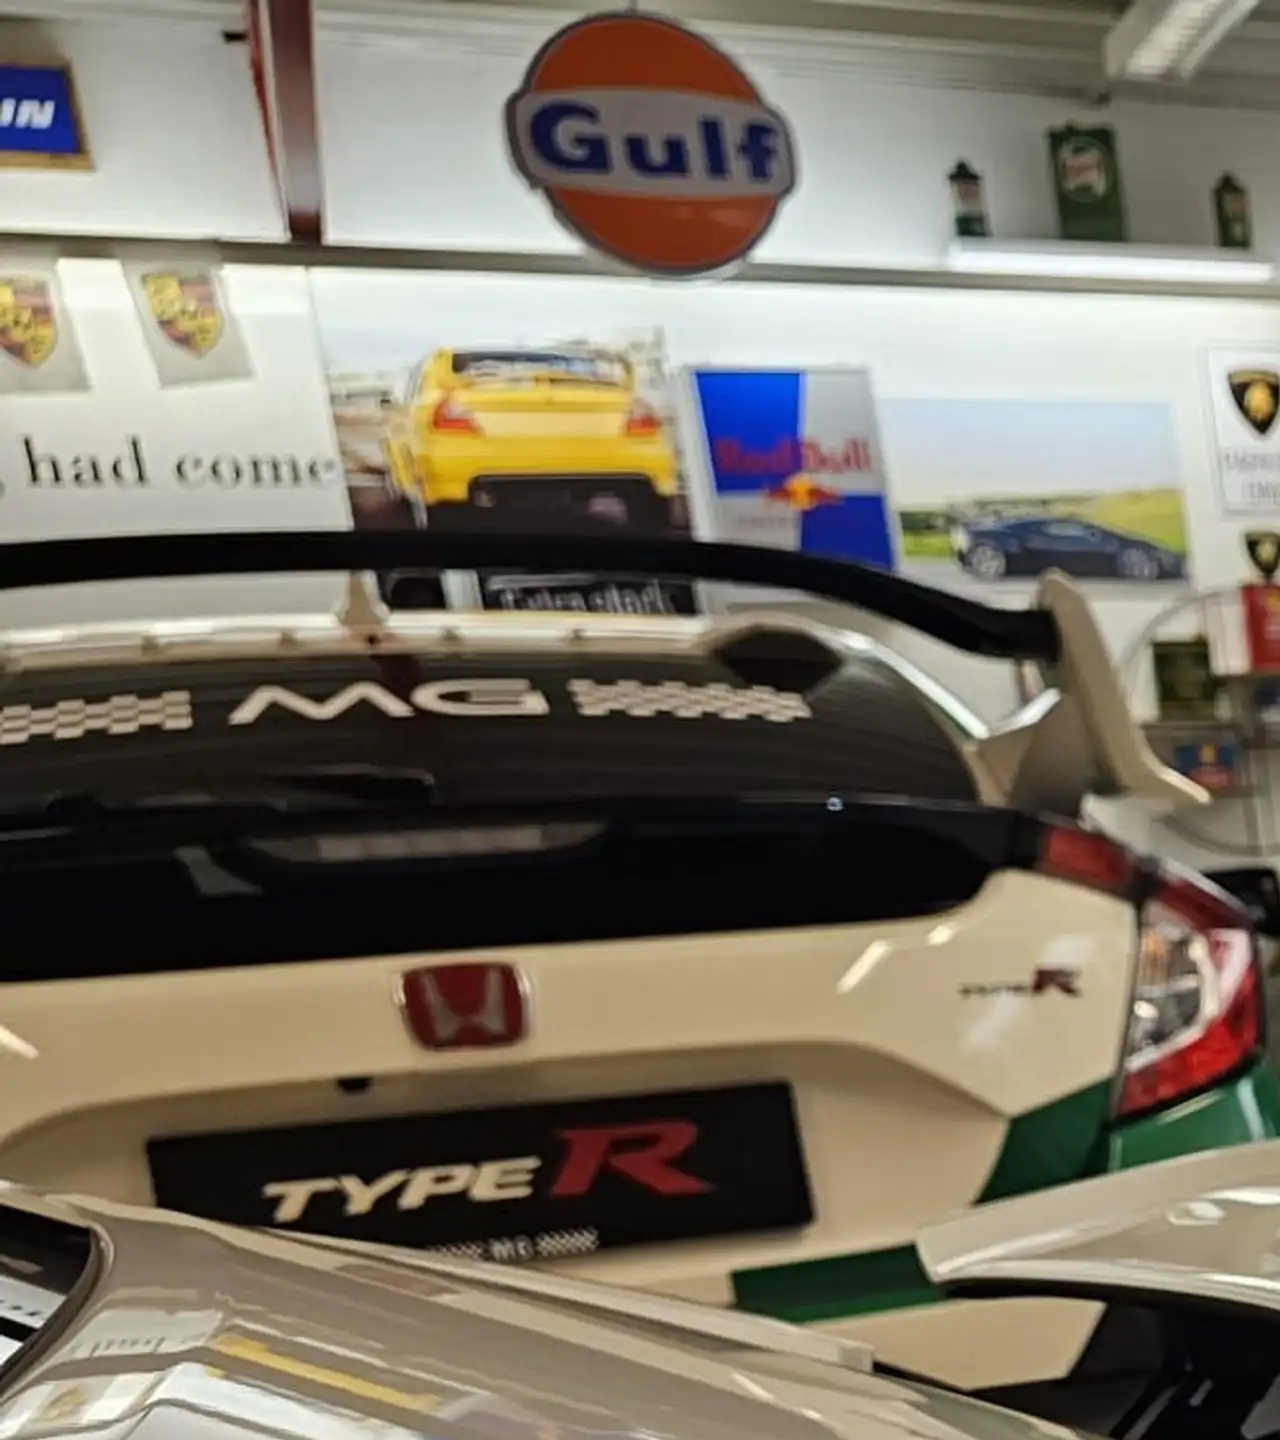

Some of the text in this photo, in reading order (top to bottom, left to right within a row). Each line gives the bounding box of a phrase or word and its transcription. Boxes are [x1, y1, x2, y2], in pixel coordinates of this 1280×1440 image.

[0, 98, 55, 129] IN
[529, 99, 779, 183] Gulf
[22, 432, 156, 489] had
[171, 452, 344, 491] come
[228, 678, 551, 726] MG
[262, 1119, 716, 1223] TYPE R
